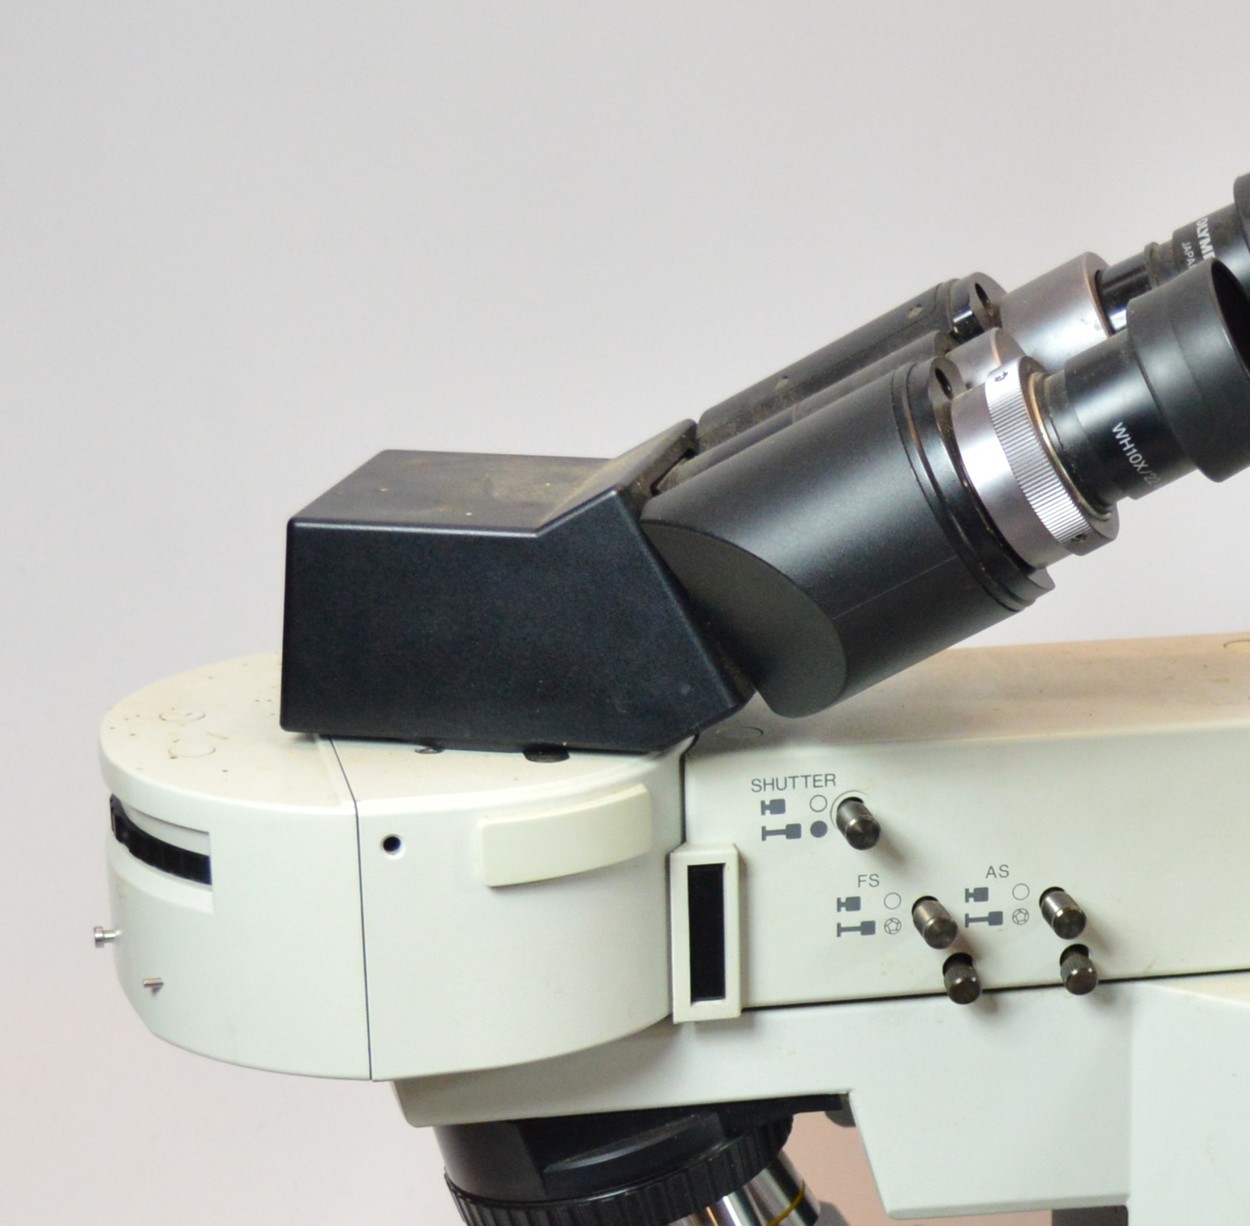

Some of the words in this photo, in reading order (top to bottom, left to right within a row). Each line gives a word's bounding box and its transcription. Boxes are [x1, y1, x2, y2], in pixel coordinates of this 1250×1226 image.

[750, 773, 837, 793] SHUTTER
[985, 864, 1010, 879] AS
[857, 873, 880, 888] FS
